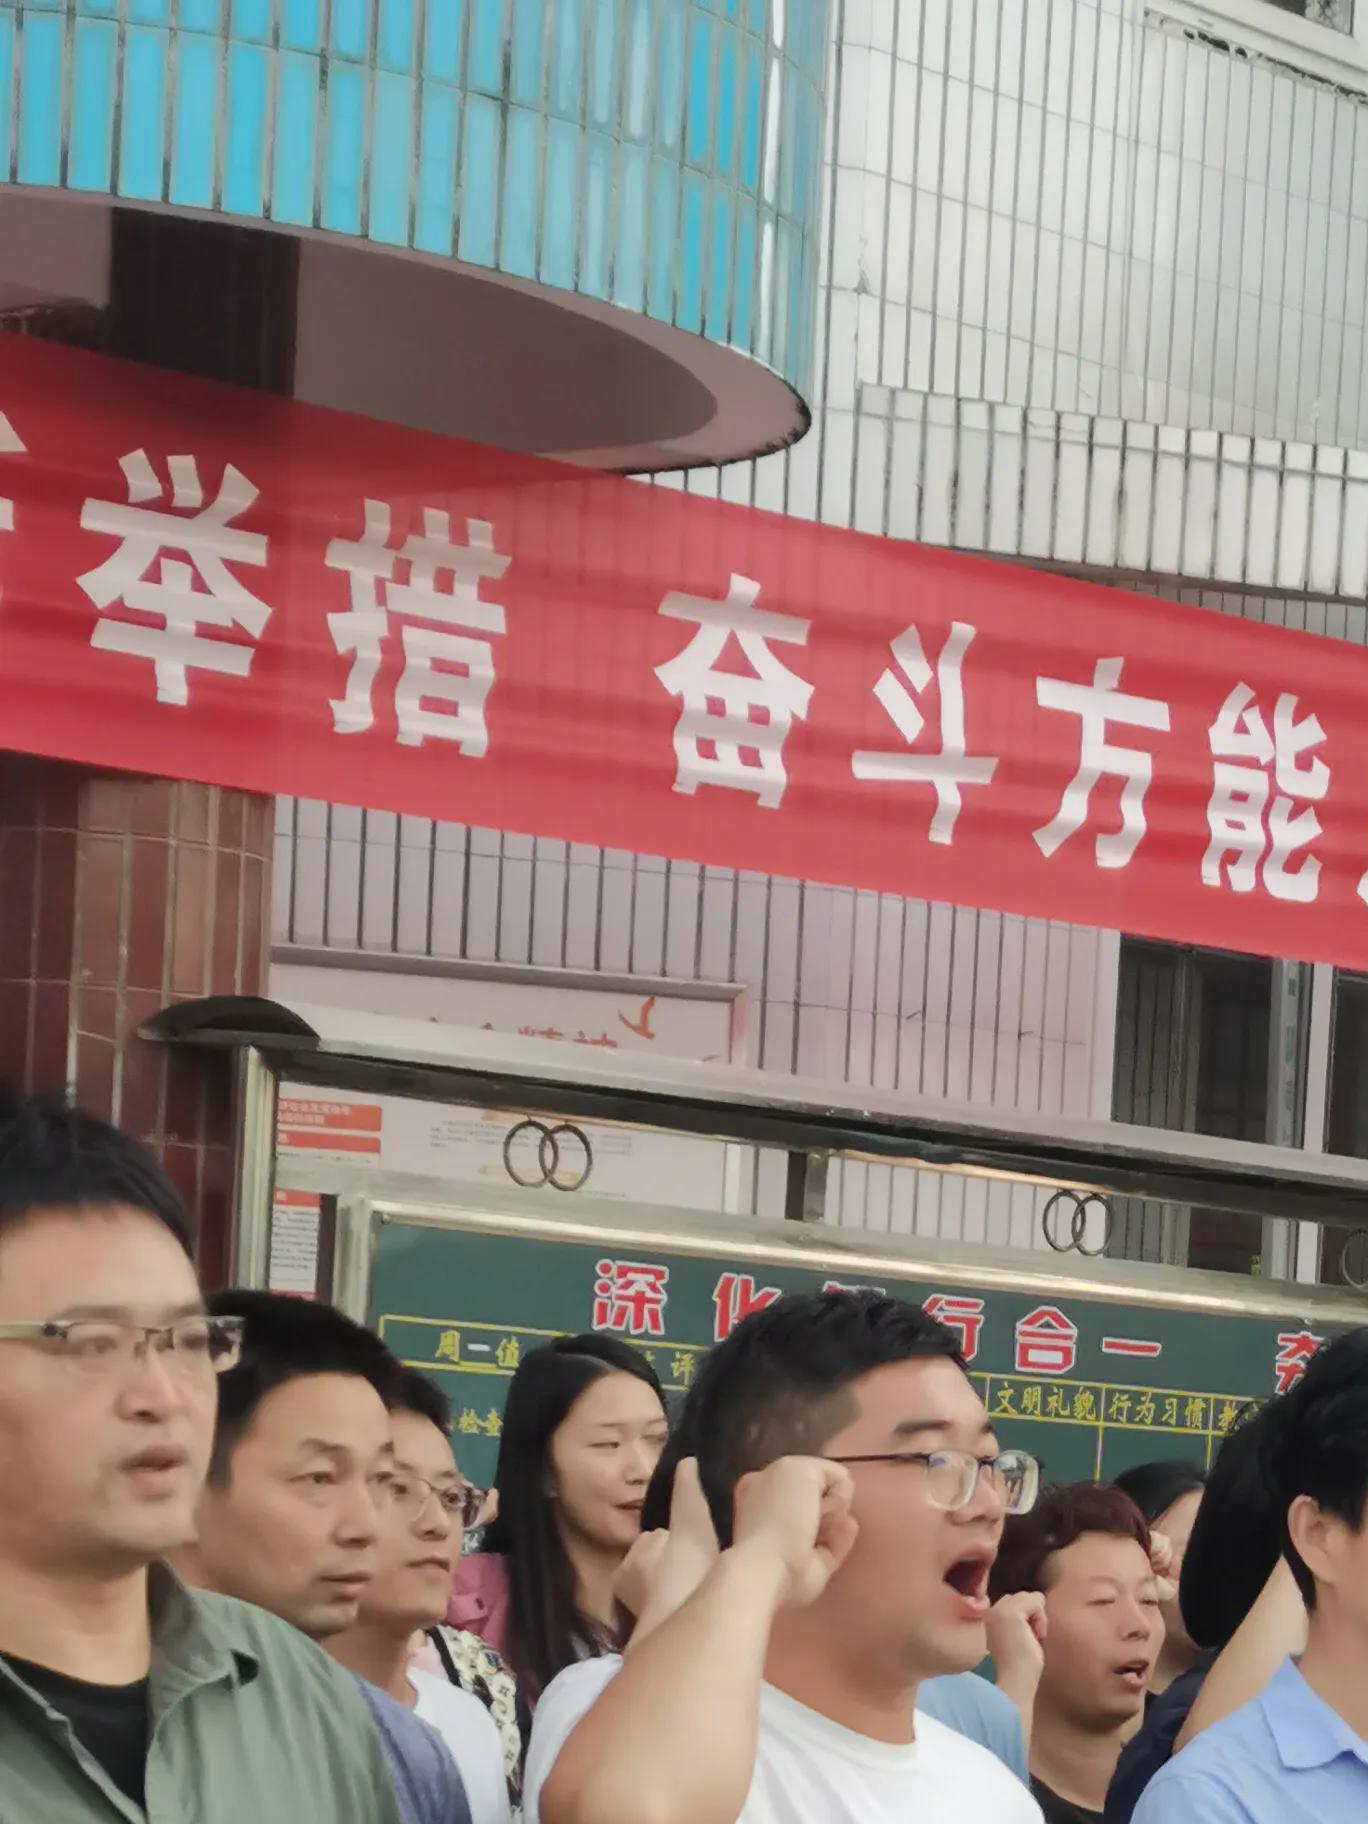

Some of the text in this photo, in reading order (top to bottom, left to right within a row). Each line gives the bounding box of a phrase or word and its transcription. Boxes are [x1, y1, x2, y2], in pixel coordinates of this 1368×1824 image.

[0, 410, 511, 758] 举措
[995, 1381, 1097, 1421] 文明礼貌
[1107, 1390, 1207, 1430] 行为习惯
